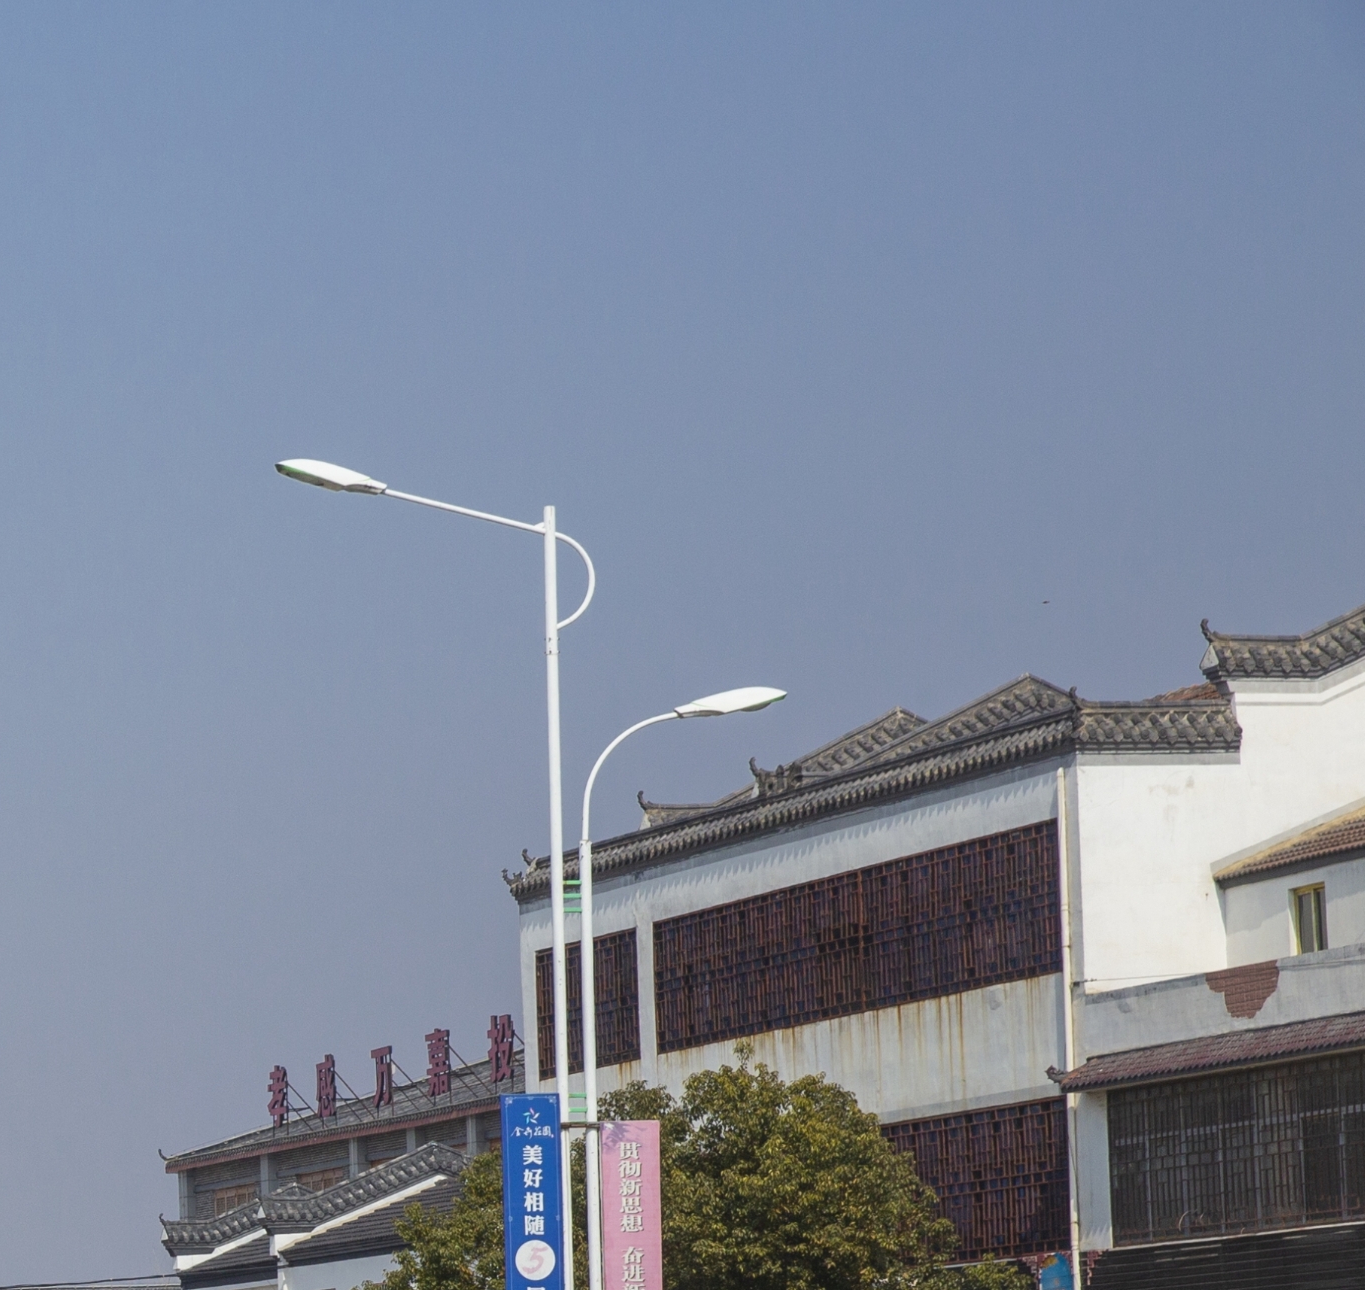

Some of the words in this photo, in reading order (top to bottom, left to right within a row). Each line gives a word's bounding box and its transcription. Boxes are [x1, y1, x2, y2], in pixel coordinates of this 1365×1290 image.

[618, 1142, 644, 1232] 贯彻新思想
